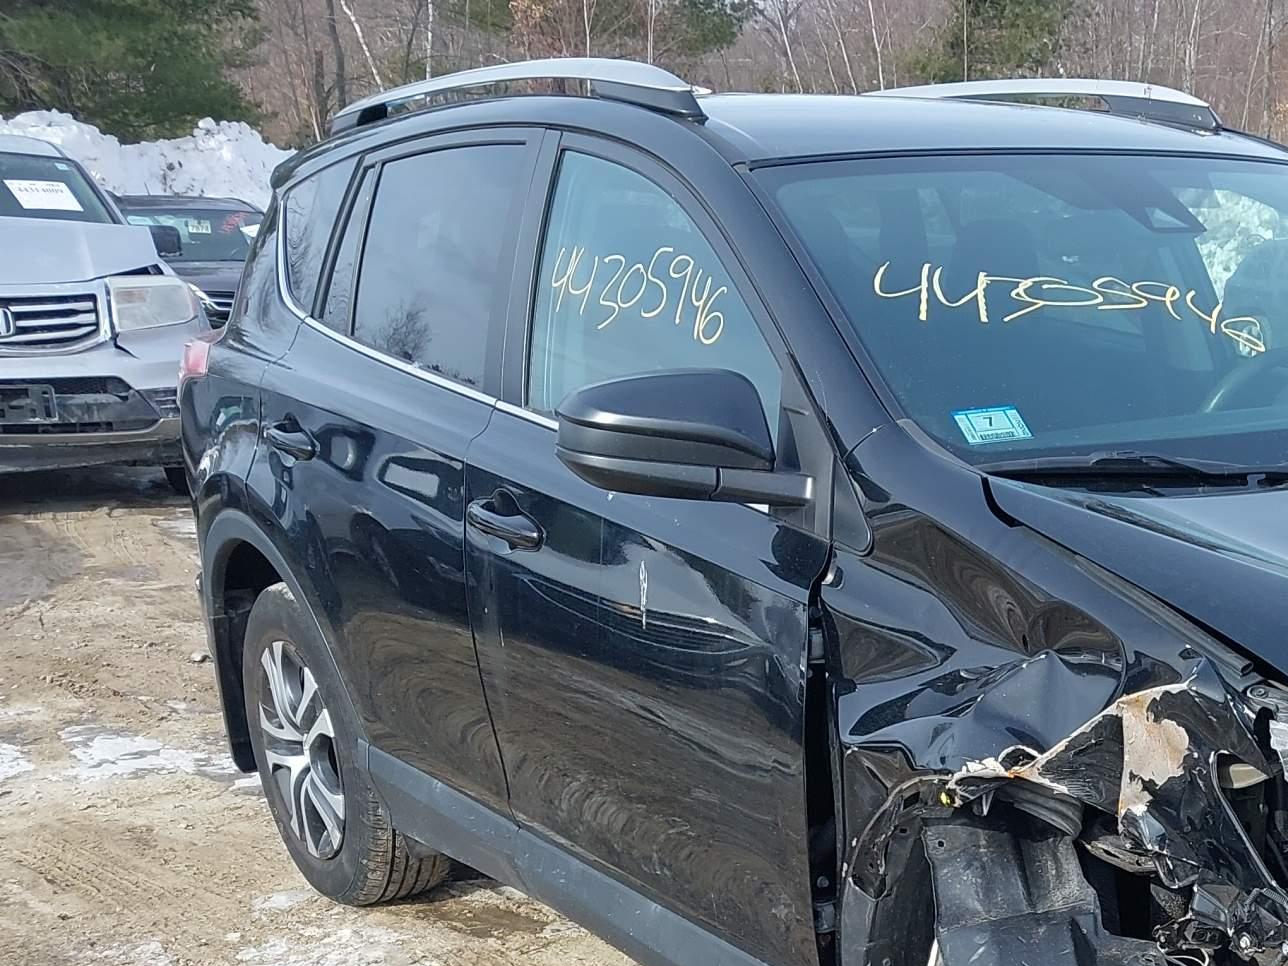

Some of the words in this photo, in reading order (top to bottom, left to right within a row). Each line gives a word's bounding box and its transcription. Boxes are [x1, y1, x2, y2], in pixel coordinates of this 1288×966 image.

[551, 246, 728, 344] 44305946
[873, 261, 1266, 352] 44305946
[983, 416, 993, 427] 7
